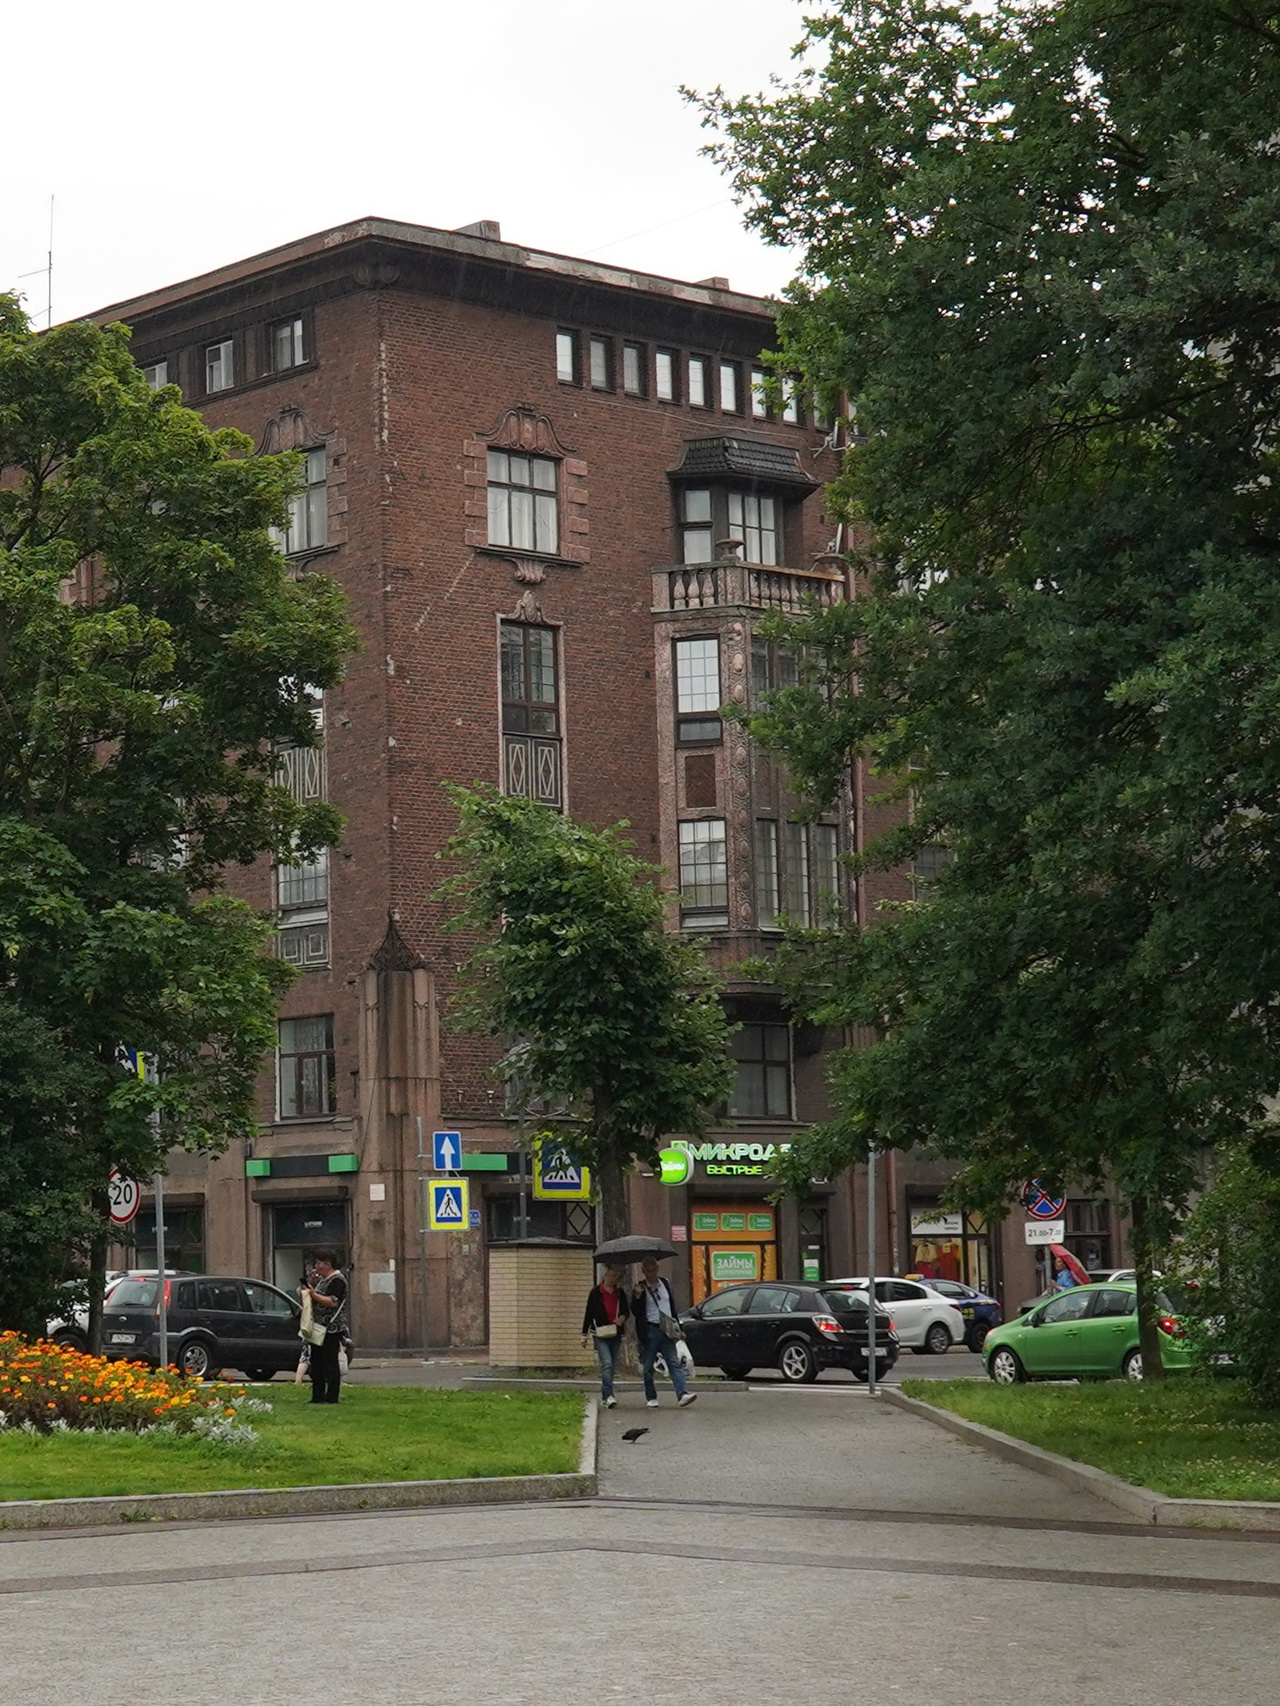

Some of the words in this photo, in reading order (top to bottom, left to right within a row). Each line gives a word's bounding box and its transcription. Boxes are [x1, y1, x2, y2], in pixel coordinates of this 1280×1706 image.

[706, 1164, 763, 1175] БЫСТРЫЕ
[113, 1183, 133, 1205] 20
[716, 1255, 753, 1269] ЗАЙМЫ
